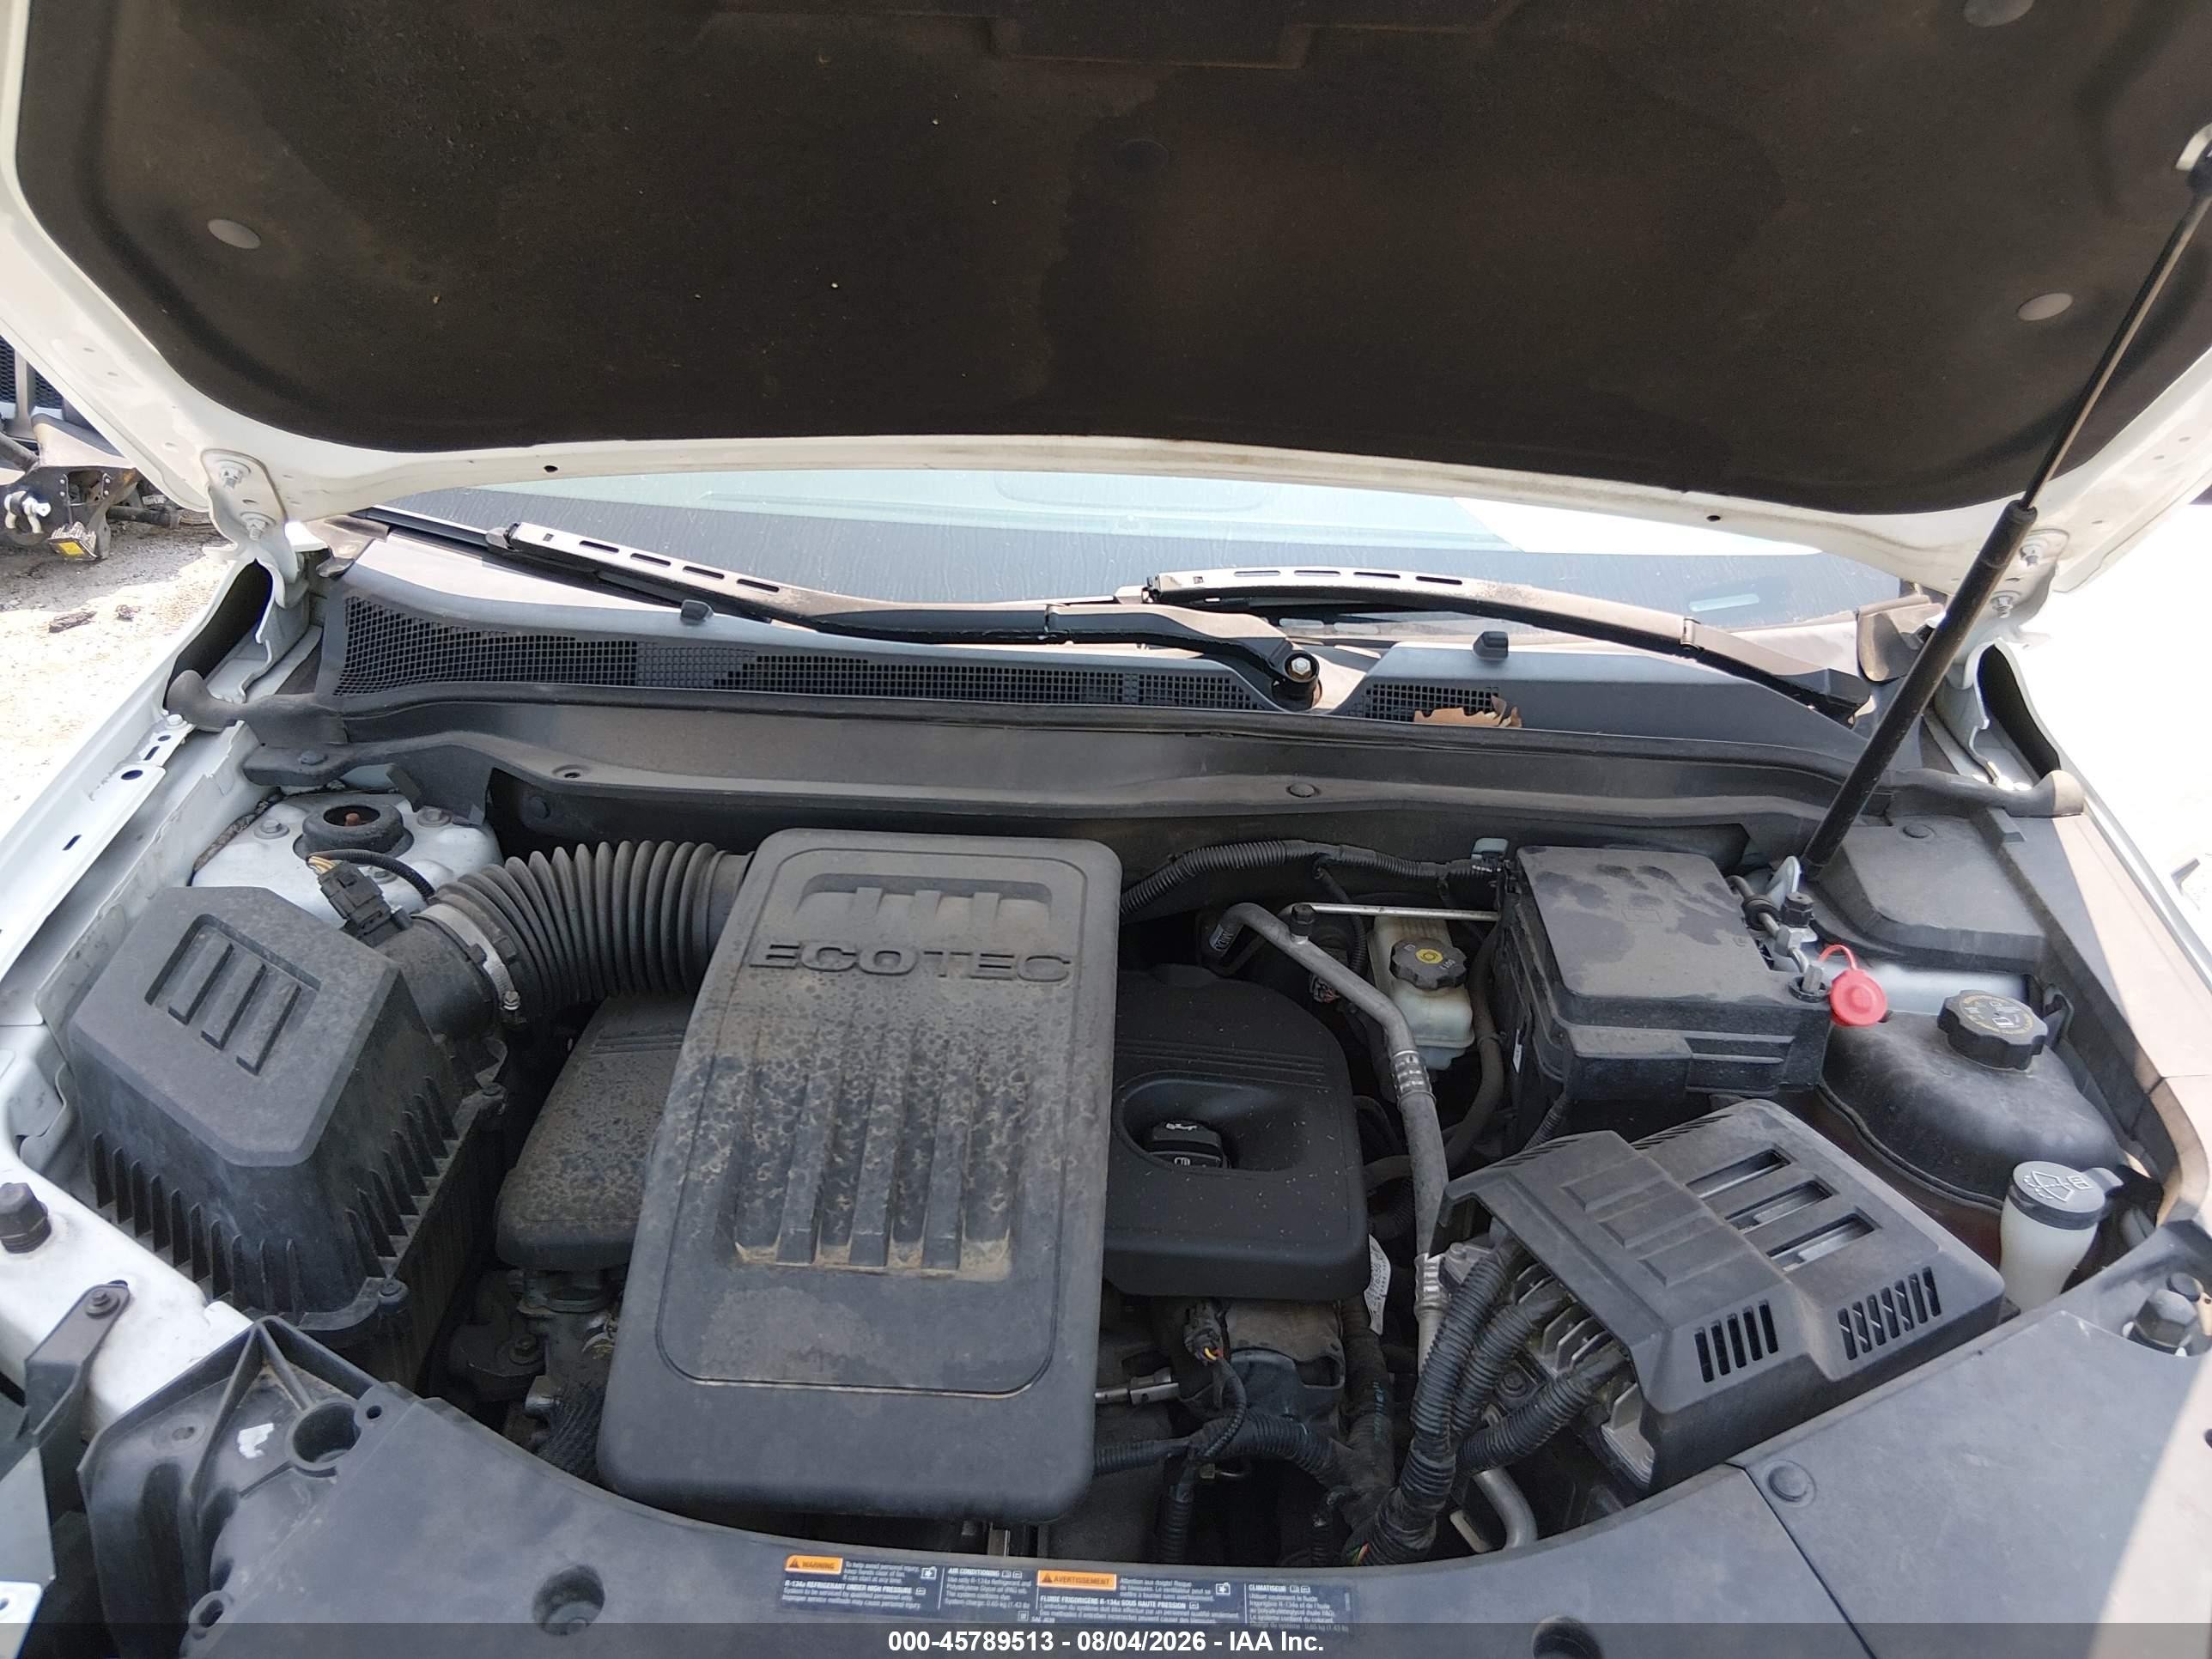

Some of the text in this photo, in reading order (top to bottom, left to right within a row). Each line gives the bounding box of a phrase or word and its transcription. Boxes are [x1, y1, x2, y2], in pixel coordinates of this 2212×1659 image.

[749, 942, 1073, 984] ECOTEC
[802, 1560, 836, 1570] WARNING
[959, 1568, 1000, 1577] CONDITIONING
[1053, 1575, 1110, 1585] AVERTISSEMENT
